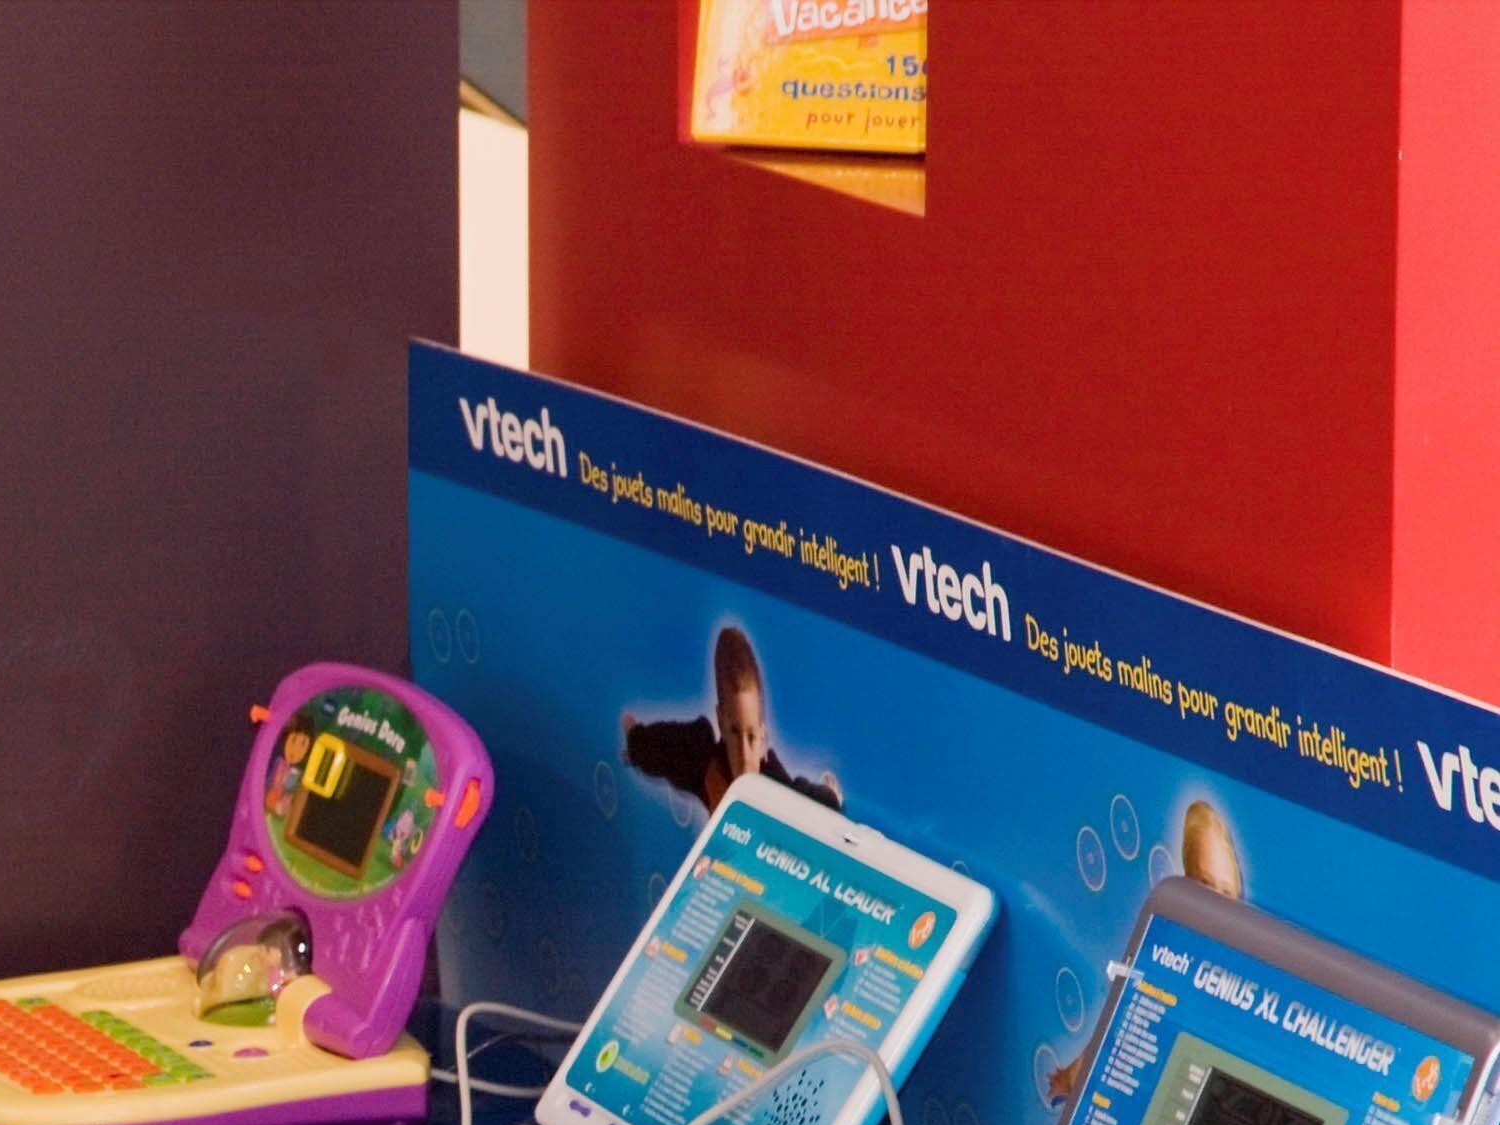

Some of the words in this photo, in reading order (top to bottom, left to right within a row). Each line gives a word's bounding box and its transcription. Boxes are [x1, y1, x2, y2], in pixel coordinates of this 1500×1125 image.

[886, 55, 928, 77] 15
[781, 78, 927, 101] questions
[806, 111, 855, 129] pour
[864, 108, 920, 133] jouer
[458, 396, 568, 478] vtech
[579, 451, 609, 491] Des
[611, 463, 654, 507] jouets
[657, 482, 702, 526] malins
[705, 503, 738, 538] pour
[743, 519, 796, 558] grandir
[799, 528, 870, 590] intelligent
[872, 552, 880, 593] !
[890, 544, 1012, 642] vtech
[1025, 613, 1059, 661] Des
[1062, 628, 1113, 683] jouets
[1117, 654, 1173, 706] malins
[1178, 681, 1219, 719] pour
[1224, 700, 1291, 749] grandir
[1297, 716, 1391, 789] intelligent
[1394, 749, 1404, 793] !
[1151, 944, 1190, 975] vtech
[1193, 959, 1260, 1012] GENIUS
[1254, 988, 1281, 1025] XL
[1282, 1000, 1396, 1077] CHALLENGER
